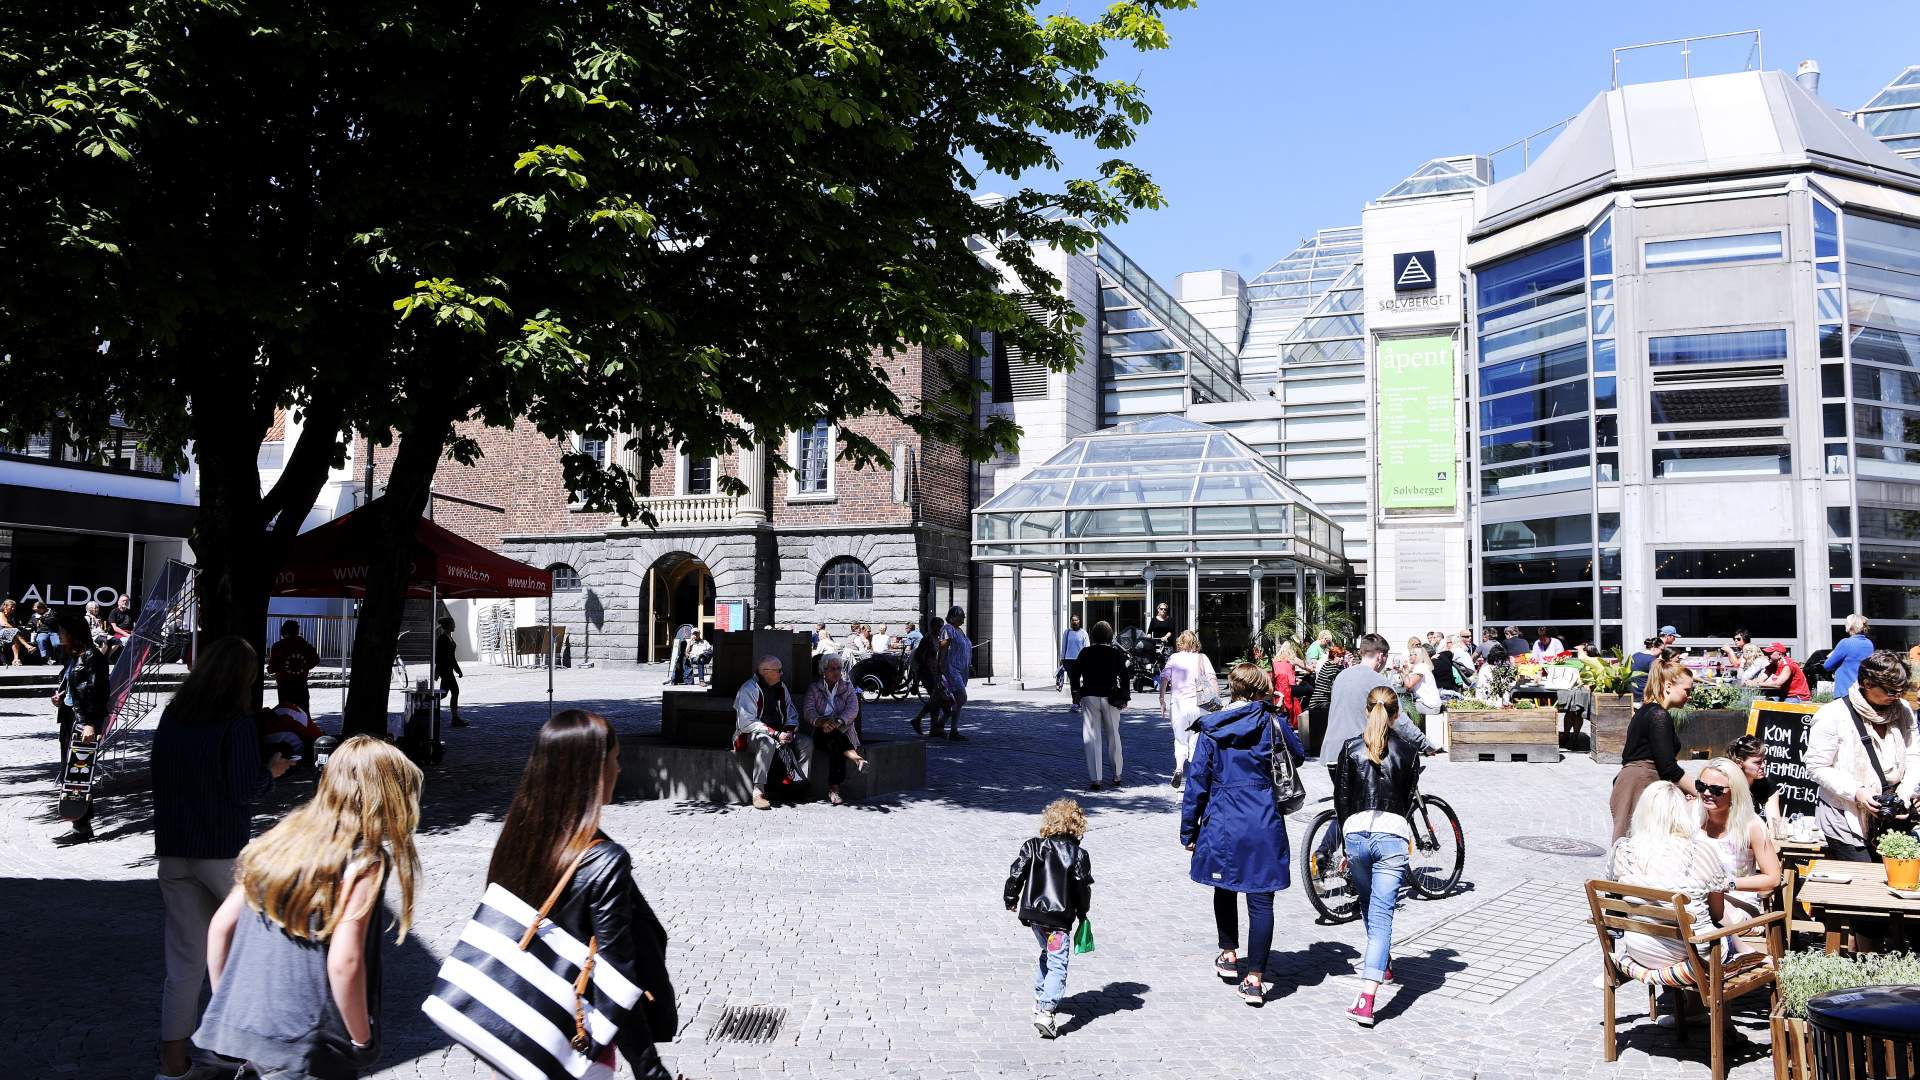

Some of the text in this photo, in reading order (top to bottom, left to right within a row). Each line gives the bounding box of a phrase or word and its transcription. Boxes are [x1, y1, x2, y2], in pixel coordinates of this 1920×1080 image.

[1379, 294, 1452, 312] SØLVBERGET
[1383, 344, 1448, 374] åpent
[1392, 485, 1444, 496] Sølvberget
[20, 584, 119, 607] ALDO
[1764, 724, 1792, 745] KOM
